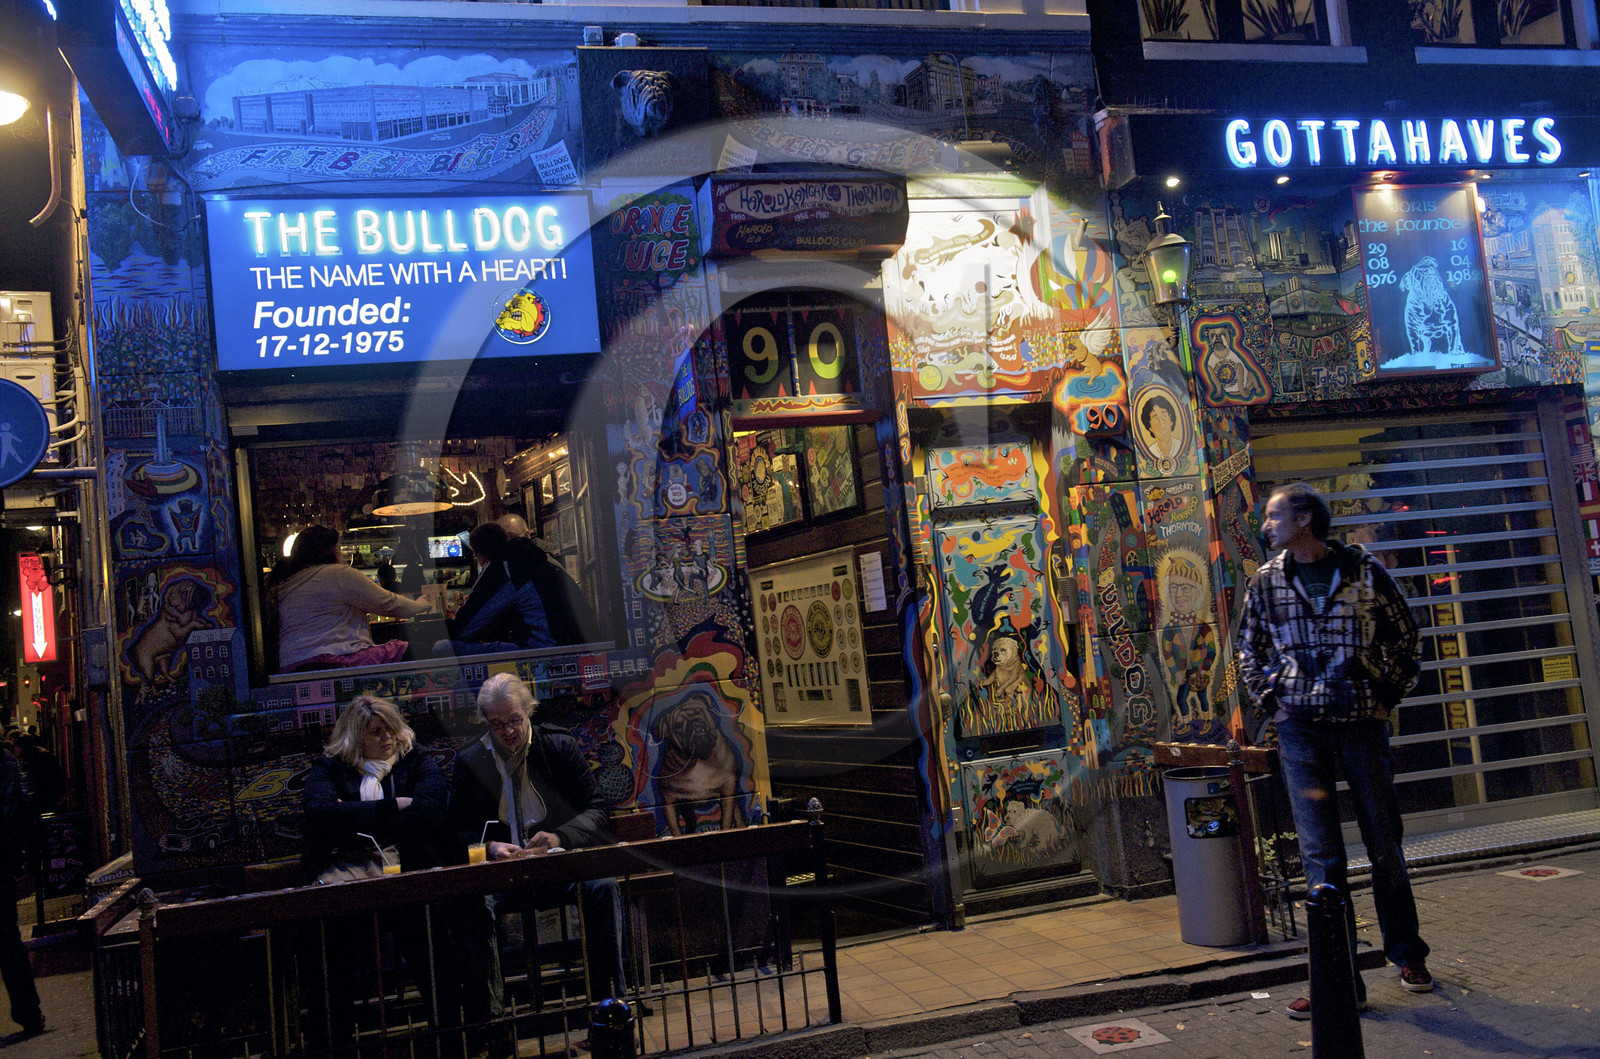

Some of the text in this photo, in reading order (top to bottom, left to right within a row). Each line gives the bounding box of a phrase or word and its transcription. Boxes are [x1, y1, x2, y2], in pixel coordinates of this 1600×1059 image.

[241, 148, 326, 166] FIRST
[329, 152, 407, 175] BEST
[427, 126, 533, 173] BIGGEST
[753, 126, 863, 164] BULLDOG
[538, 154, 569, 171] BULLDOGS
[541, 163, 572, 178] DECORATE
[561, 172, 577, 183] HALL
[244, 205, 565, 257] THE BULLDOG
[609, 202, 693, 236] ORANGE
[1358, 217, 1389, 234] the
[796, 236, 840, 247] BULLDOG
[1368, 237, 1468, 256] 29 16
[609, 239, 690, 272] JUICE
[1368, 254, 1473, 270] 08 04
[250, 256, 567, 290] THE NAME WITH A HEART!
[1366, 269, 1397, 288] 1976
[254, 296, 411, 330] Founded:
[255, 330, 404, 358] 17-12-1975
[1279, 332, 1346, 359] CANADA
[1087, 403, 1118, 430] 90
[1159, 520, 1204, 539] THORNTON
[1098, 566, 1155, 728] BULLDOG
